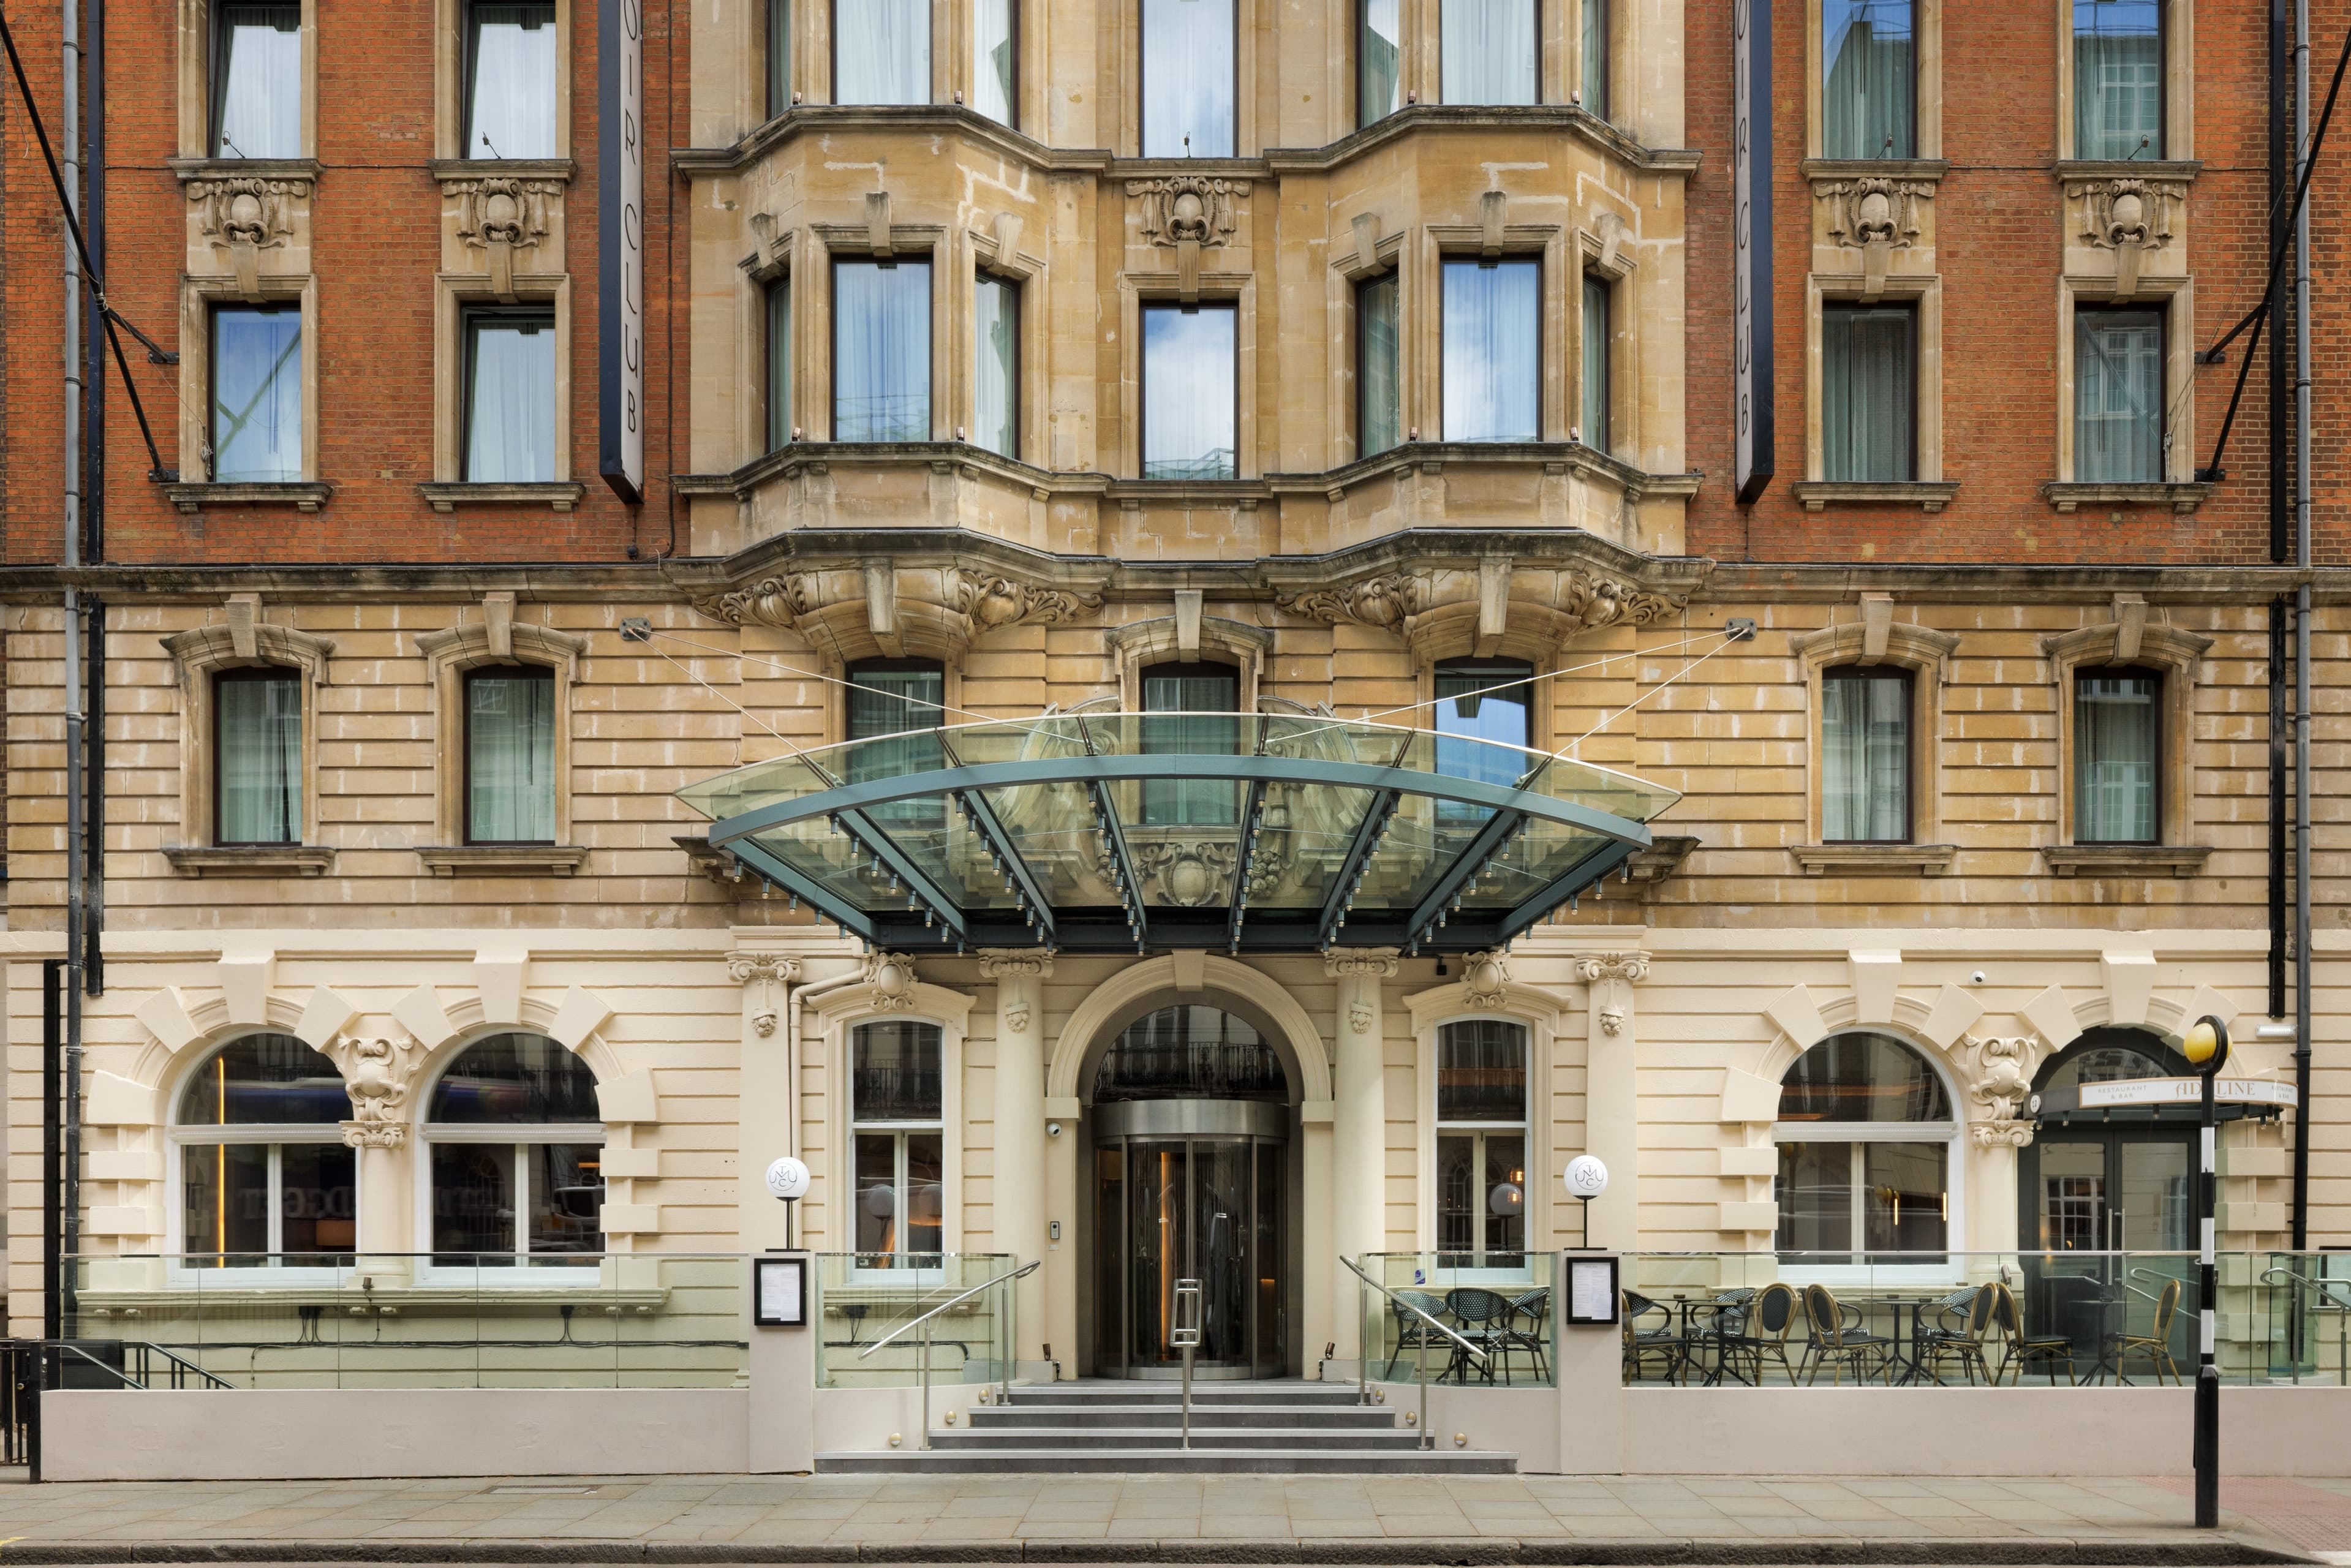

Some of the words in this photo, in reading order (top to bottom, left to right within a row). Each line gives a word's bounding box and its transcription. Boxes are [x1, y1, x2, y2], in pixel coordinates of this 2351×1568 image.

[624, 203, 638, 433] CLUB
[1738, 201, 1749, 437] CLUB
[2176, 1082, 2255, 1098] ADLINE
